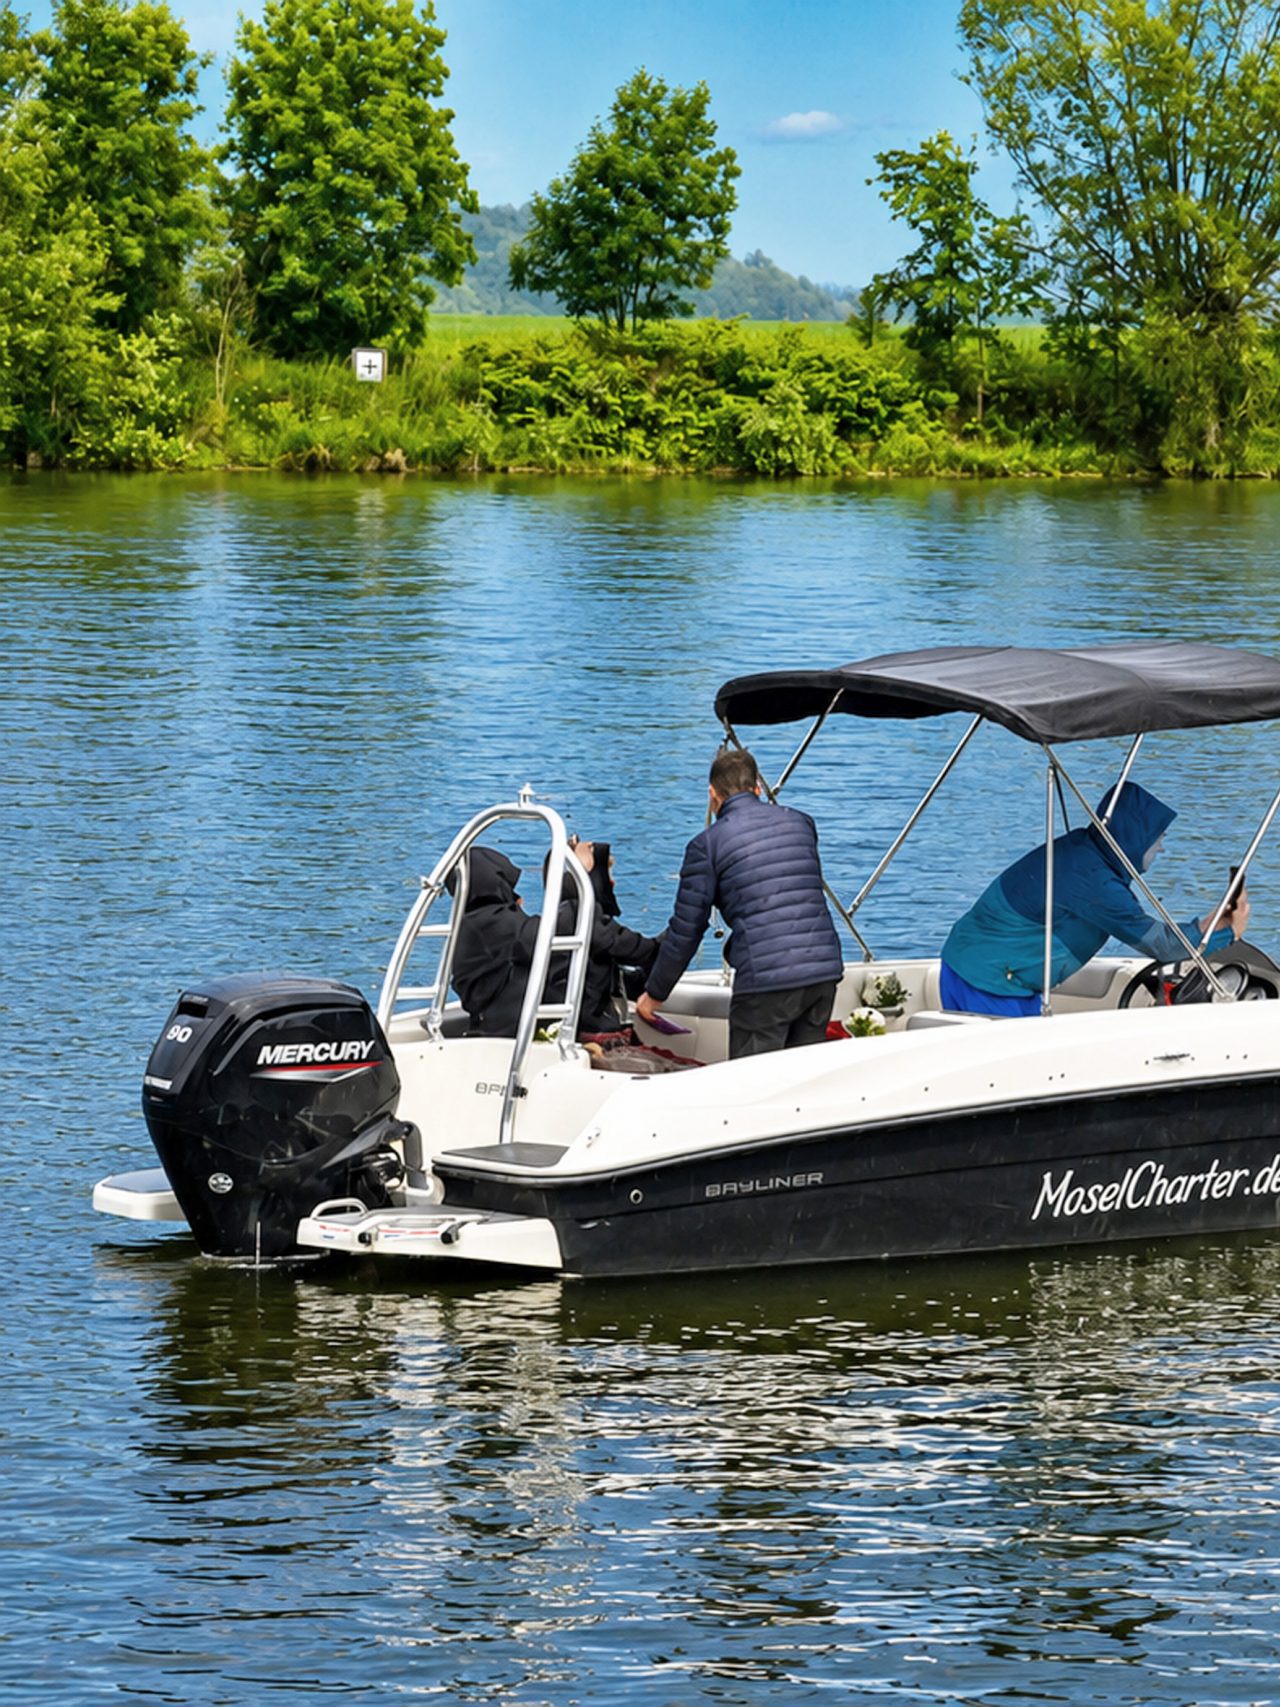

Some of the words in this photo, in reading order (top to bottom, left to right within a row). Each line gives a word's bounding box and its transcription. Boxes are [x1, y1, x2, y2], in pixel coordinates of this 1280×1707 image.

[166, 1024, 193, 1043] 90
[256, 1040, 375, 1065] MERCURY
[705, 1172, 824, 1198] BAYLINER
